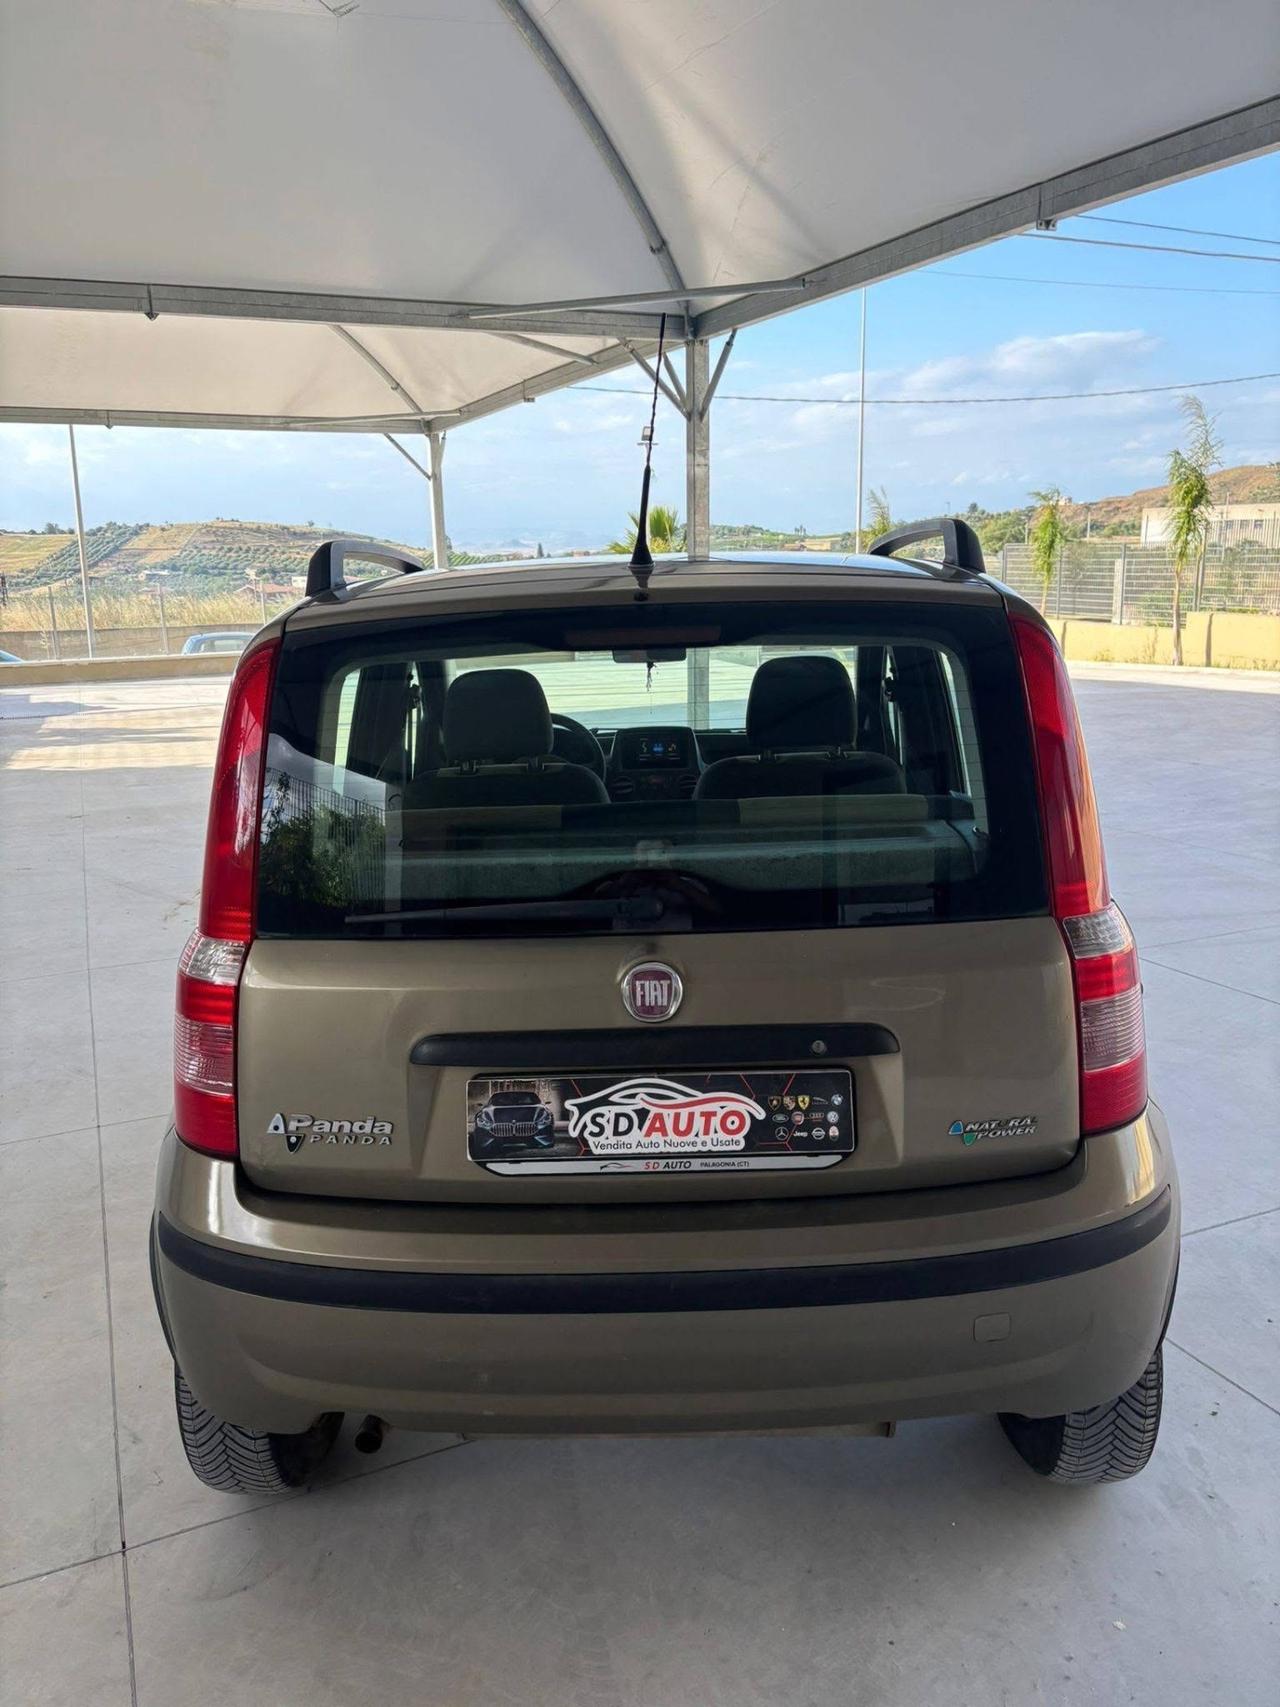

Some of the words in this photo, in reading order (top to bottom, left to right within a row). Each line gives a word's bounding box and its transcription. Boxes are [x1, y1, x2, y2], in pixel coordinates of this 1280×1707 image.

[635, 980, 671, 1007] FIAT
[287, 1113, 392, 1134] Panda
[643, 1109, 746, 1137] AUTO
[310, 1134, 392, 1145] PANDA
[977, 1126, 1036, 1140] POWER
[593, 1140, 632, 1150] Vendita
[636, 1139, 660, 1149] Auto
[663, 1138, 697, 1149] Nuove
[701, 1139, 708, 1147] e
[710, 1137, 741, 1147] Usate
[662, 1160, 692, 1170] AUTO
[736, 1160, 750, 1168] (CT)
